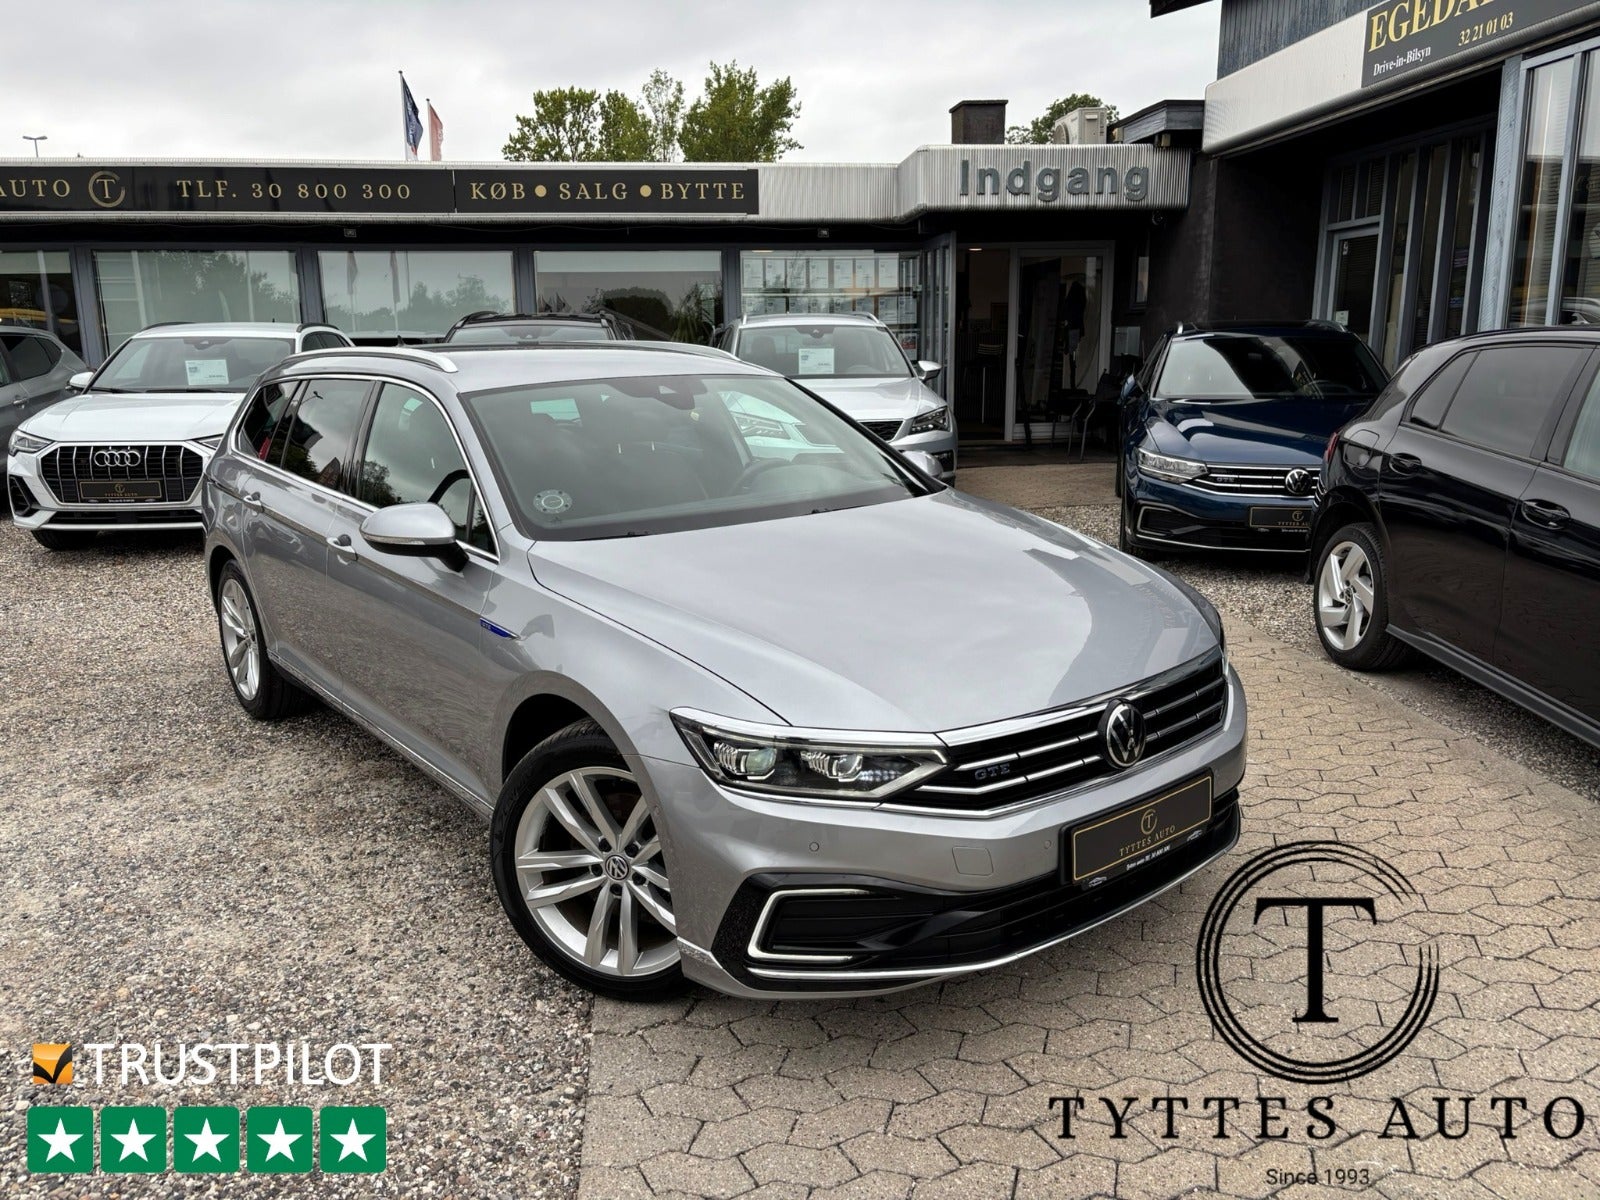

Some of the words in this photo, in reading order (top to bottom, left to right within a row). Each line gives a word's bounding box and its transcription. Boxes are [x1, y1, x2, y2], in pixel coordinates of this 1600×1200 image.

[1368, 0, 1495, 52] EGED
[1458, 28, 1470, 47] 32
[1472, 23, 1483, 42] 21
[1486, 17, 1498, 36] 01
[1500, 11, 1513, 31] 03
[1373, 46, 1431, 76] Drive-in-Bilsyn
[177, 180, 237, 199] TLF.
[252, 183, 282, 199] 30
[298, 184, 347, 199] 800
[362, 184, 411, 200] 300
[470, 182, 526, 200] KØB
[560, 182, 628, 200] SALG
[660, 182, 744, 200] BYTTE
[960, 159, 1149, 202] Indgang
[975, 763, 1010, 781] GTE
[1120, 836, 1151, 856] TYTTES
[1155, 825, 1175, 842] AUTO
